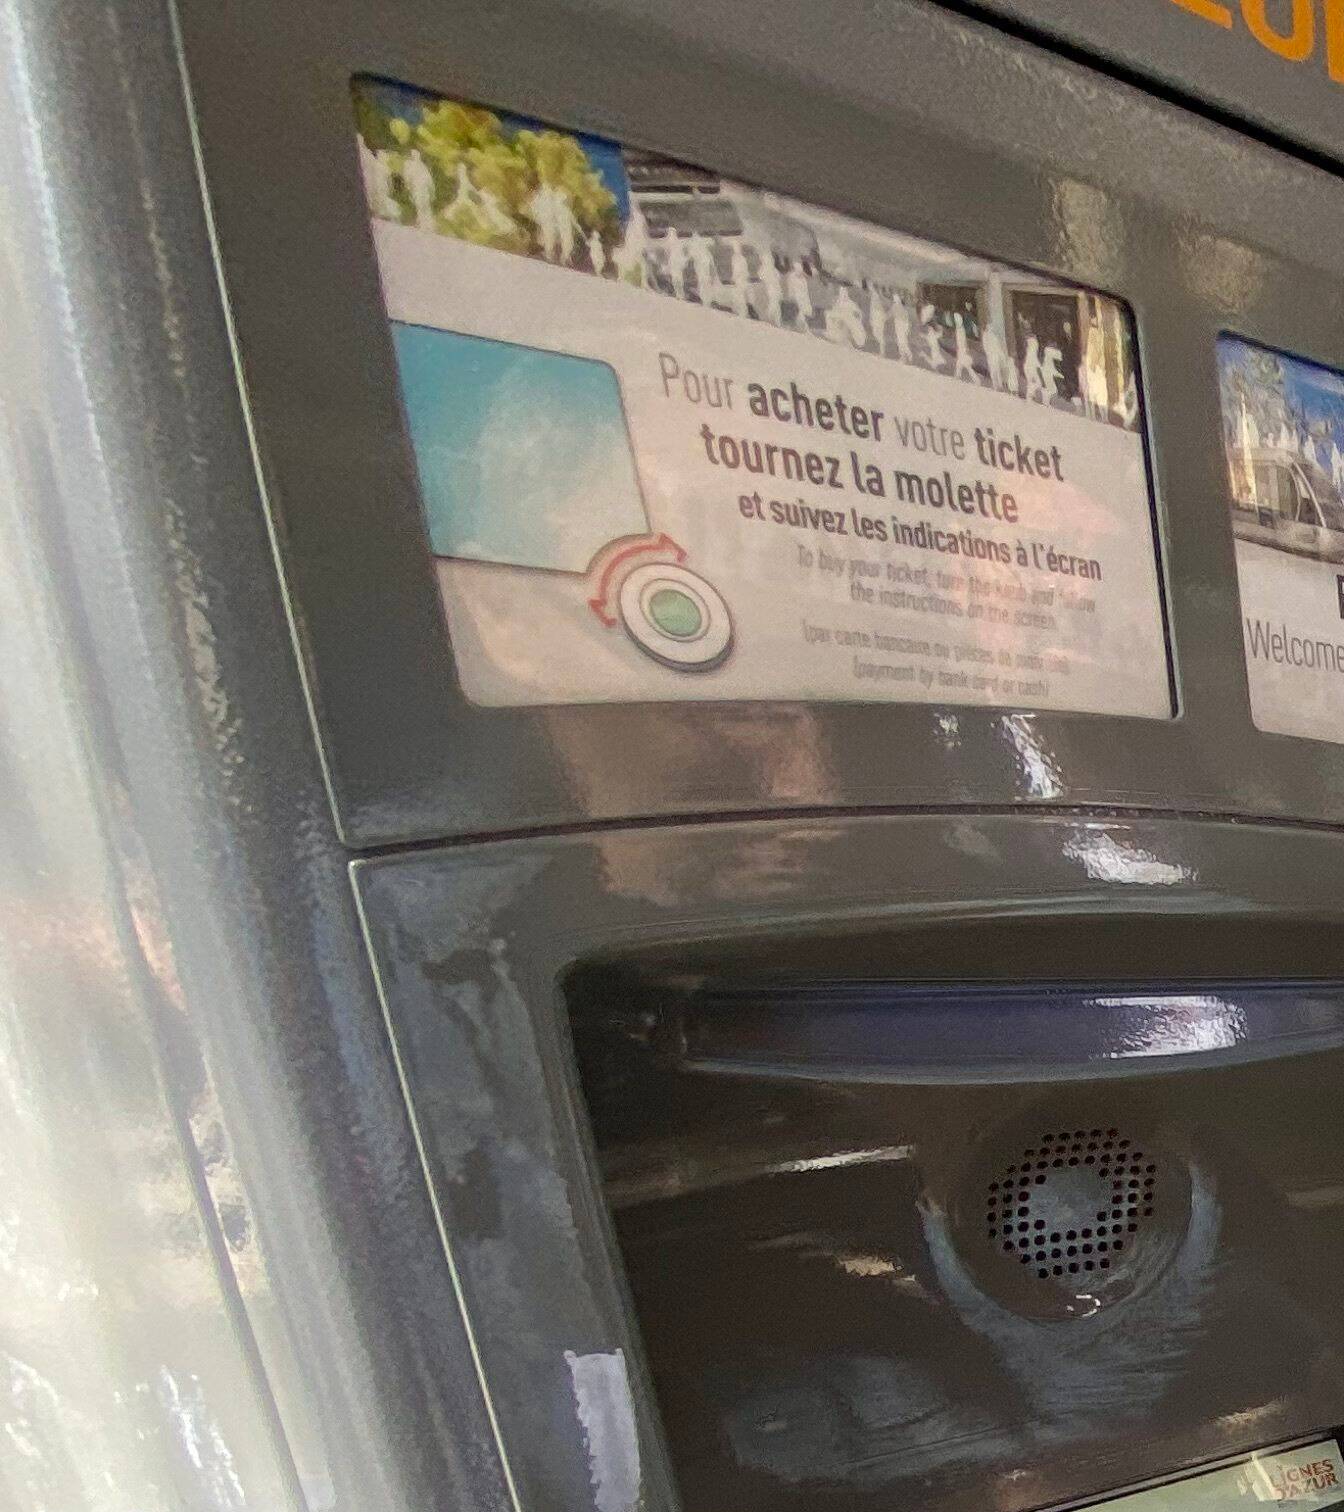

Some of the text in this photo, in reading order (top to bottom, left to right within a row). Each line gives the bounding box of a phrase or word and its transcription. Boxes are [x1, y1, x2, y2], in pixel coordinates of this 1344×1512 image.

[659, 352, 1064, 482] Pour acheter votre ticket
[700, 423, 1018, 524] tournez la molette
[738, 491, 1103, 581] et suivez les indications à l'écran
